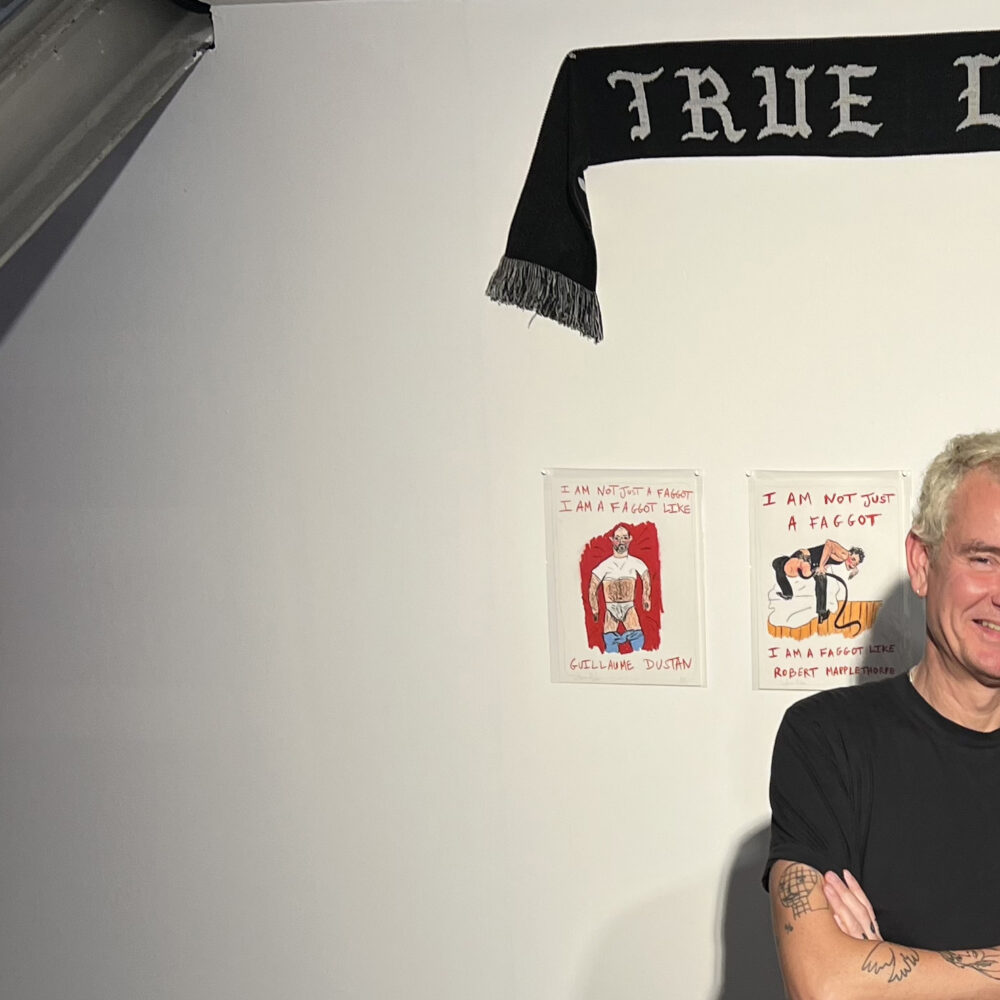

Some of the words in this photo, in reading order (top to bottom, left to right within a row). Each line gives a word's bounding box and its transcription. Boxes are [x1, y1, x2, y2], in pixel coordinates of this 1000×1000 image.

[607, 64, 883, 144] TRUE
[561, 485, 570, 494] I
[575, 486, 591, 495] AM
[597, 485, 617, 496] NOT
[619, 486, 643, 499] JUST
[647, 487, 653, 497] A
[657, 487, 694, 501] FAGGOT
[762, 492, 776, 507] I
[787, 492, 812, 506] AM
[824, 491, 858, 505] NOT
[861, 492, 896, 509] JUST
[559, 500, 572, 512] I
[575, 501, 592, 512] AM
[597, 501, 604, 512] A
[610, 501, 657, 514] FAGGOT
[663, 503, 691, 515] LIKE
[788, 515, 797, 531] A
[809, 513, 882, 528] FAGGOT
[768, 647, 779, 659] I
[785, 647, 802, 657] AM
[807, 647, 814, 656] A
[820, 645, 863, 656] FAGGOT
[868, 643, 895, 654] LIKE
[570, 658, 635, 672] GUILLAUME
[645, 658, 692, 671] DUSTAN
[773, 666, 818, 679] ROBERT
[826, 665, 895, 677] MAPPLETHORPE
